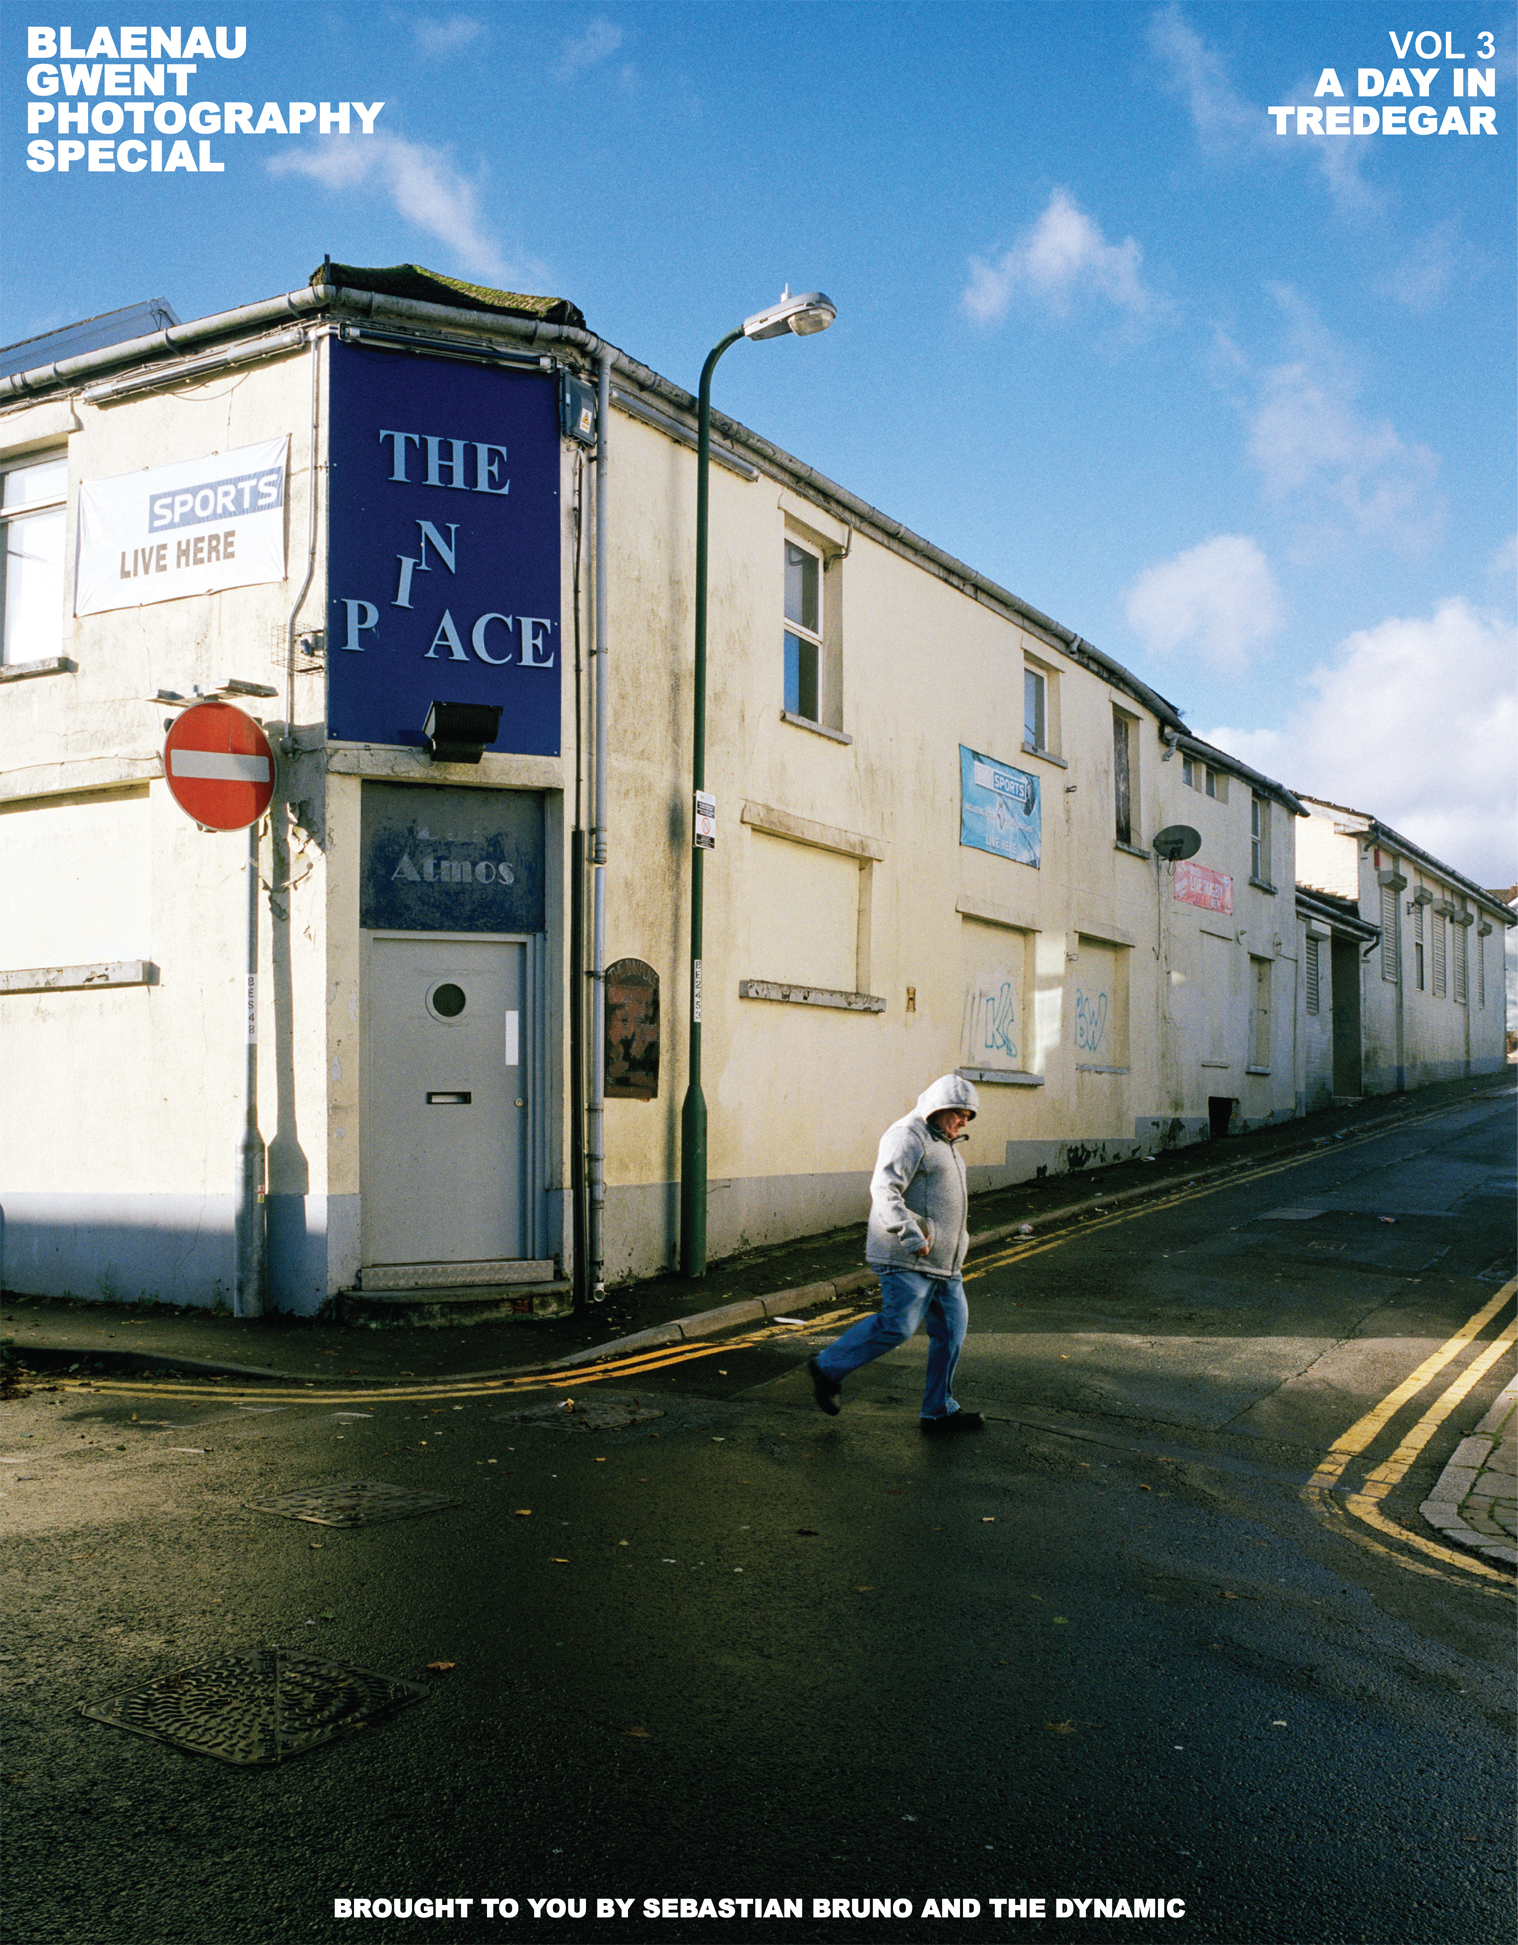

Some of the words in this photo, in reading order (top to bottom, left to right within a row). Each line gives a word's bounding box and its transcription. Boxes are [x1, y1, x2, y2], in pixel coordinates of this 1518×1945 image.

[379, 429, 510, 495] THE
[153, 473, 278, 527] SPORTS
[119, 543, 168, 580] LIVE
[176, 530, 236, 569] HERE
[994, 774, 1025, 797] SPORTS
[986, 835, 1000, 849] LIVE
[391, 852, 515, 885] Atmos
